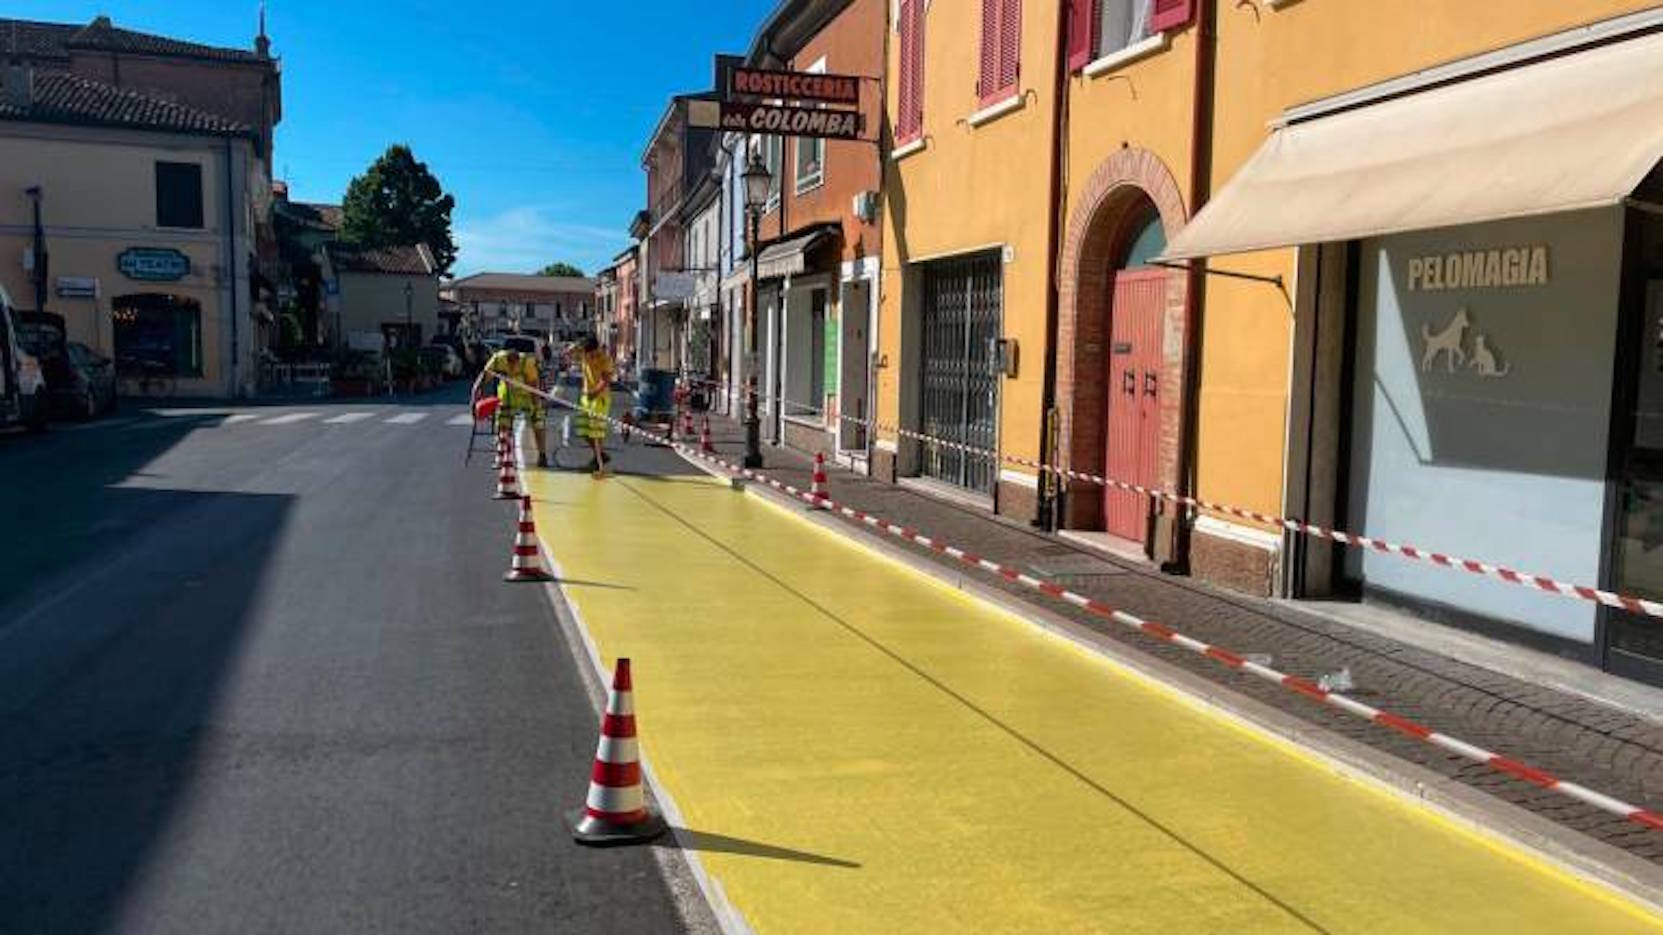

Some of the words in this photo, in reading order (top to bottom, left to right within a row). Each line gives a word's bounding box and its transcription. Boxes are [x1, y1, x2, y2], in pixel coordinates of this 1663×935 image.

[735, 71, 856, 99] ROSTICCERIA
[750, 107, 856, 136] COLOMBA
[1408, 246, 1548, 291] PELOMAGIA
